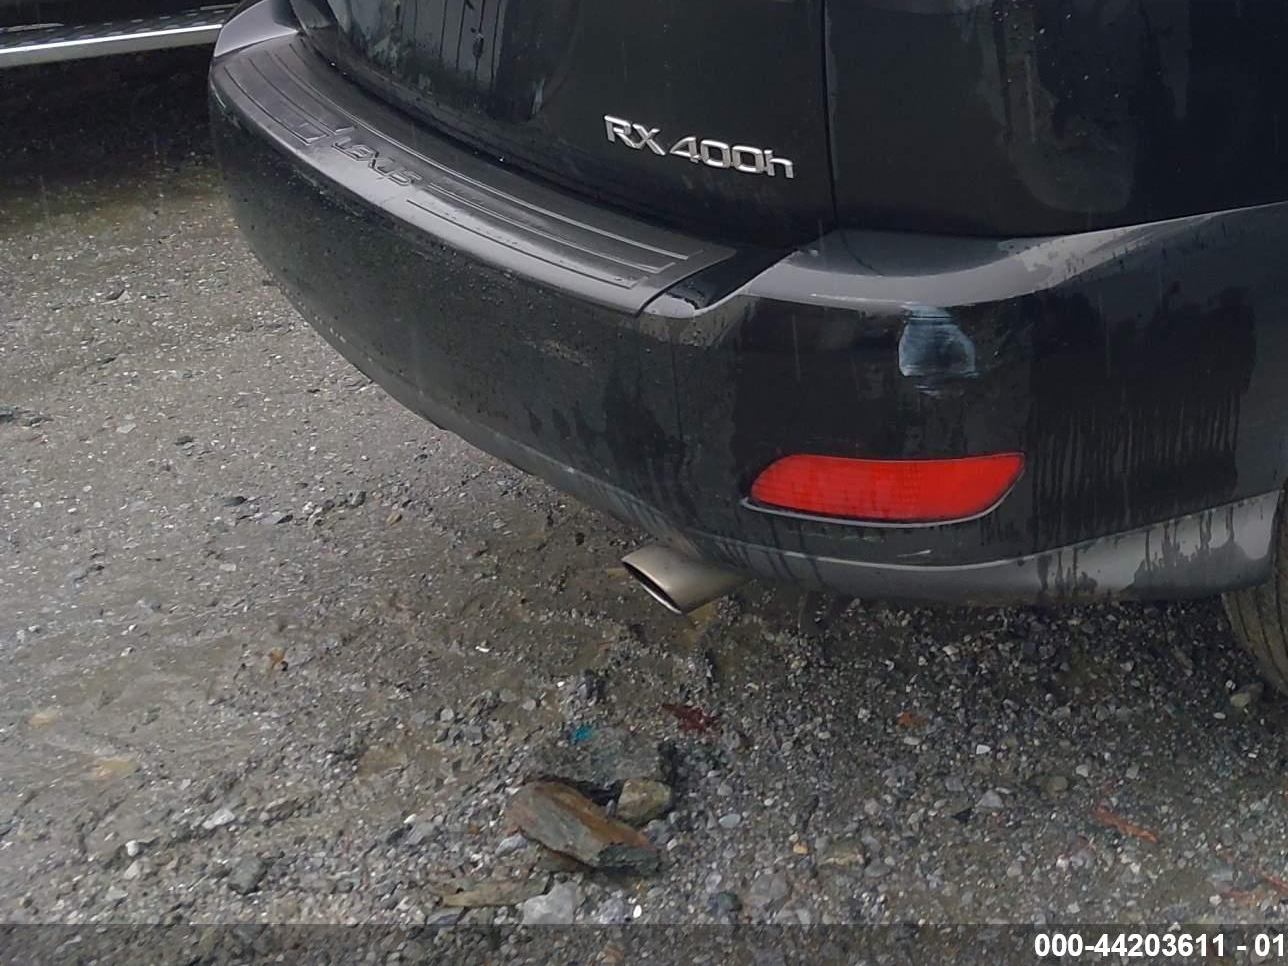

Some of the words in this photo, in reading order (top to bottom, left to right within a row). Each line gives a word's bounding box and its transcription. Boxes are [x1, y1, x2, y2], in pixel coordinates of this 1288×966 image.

[331, 136, 422, 187] LEXUS
[604, 115, 666, 156] RX
[669, 136, 794, 179] 400h
